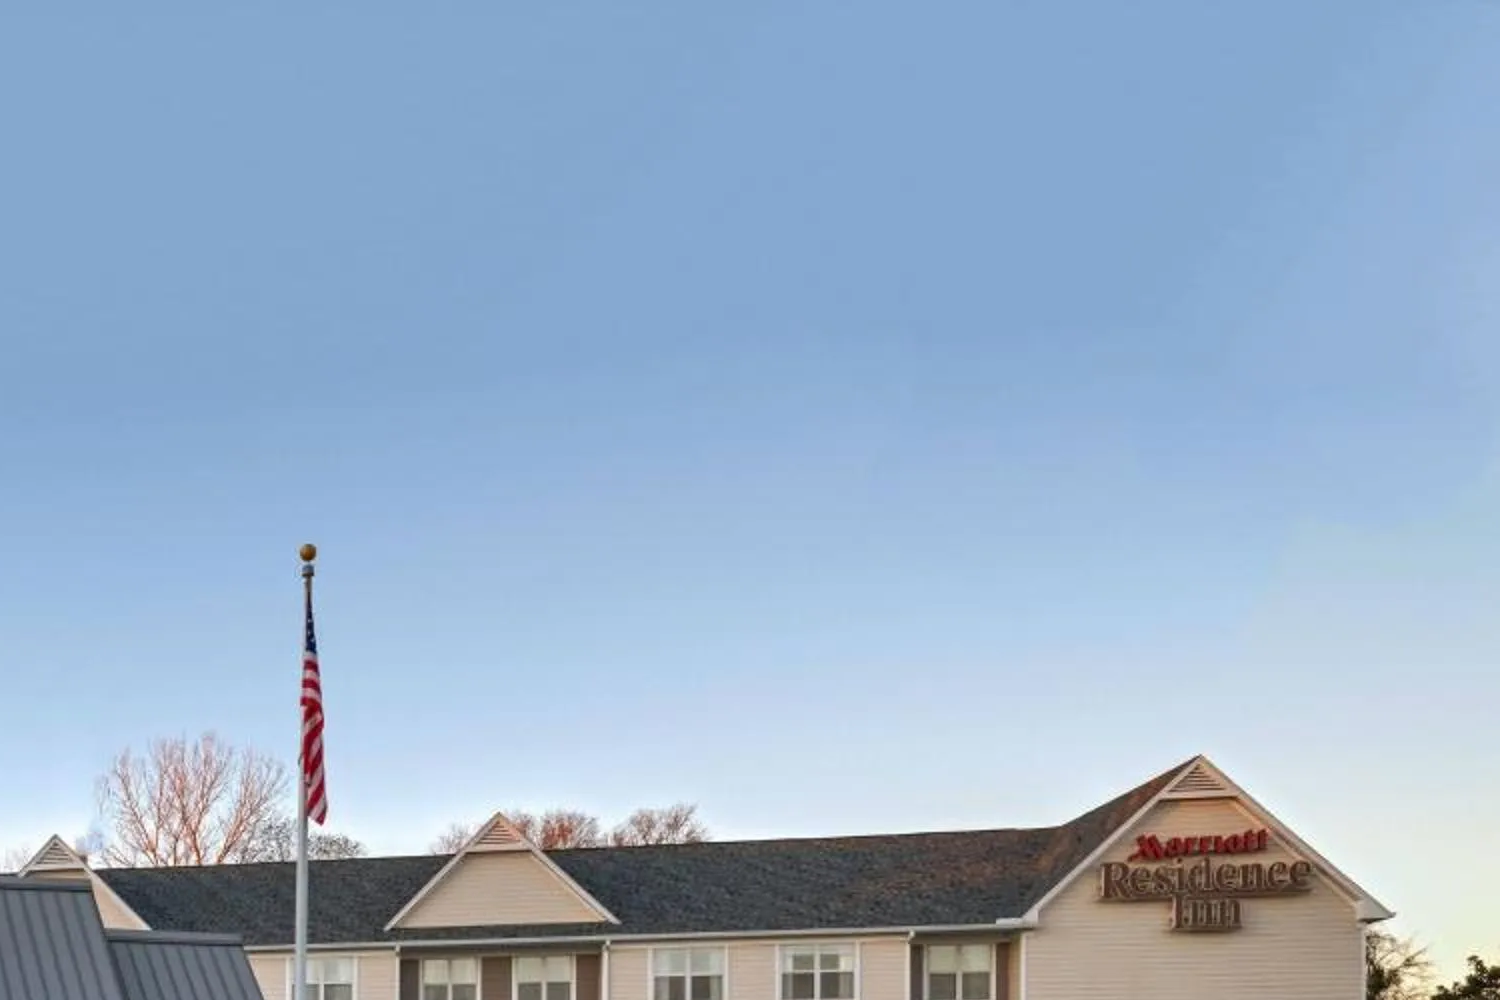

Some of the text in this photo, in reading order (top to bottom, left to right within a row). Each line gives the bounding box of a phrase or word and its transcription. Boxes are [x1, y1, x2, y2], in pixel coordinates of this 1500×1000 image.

[1127, 828, 1269, 862] Marriott
[1100, 857, 1312, 899] Residence
[1169, 895, 1241, 930] Inn
